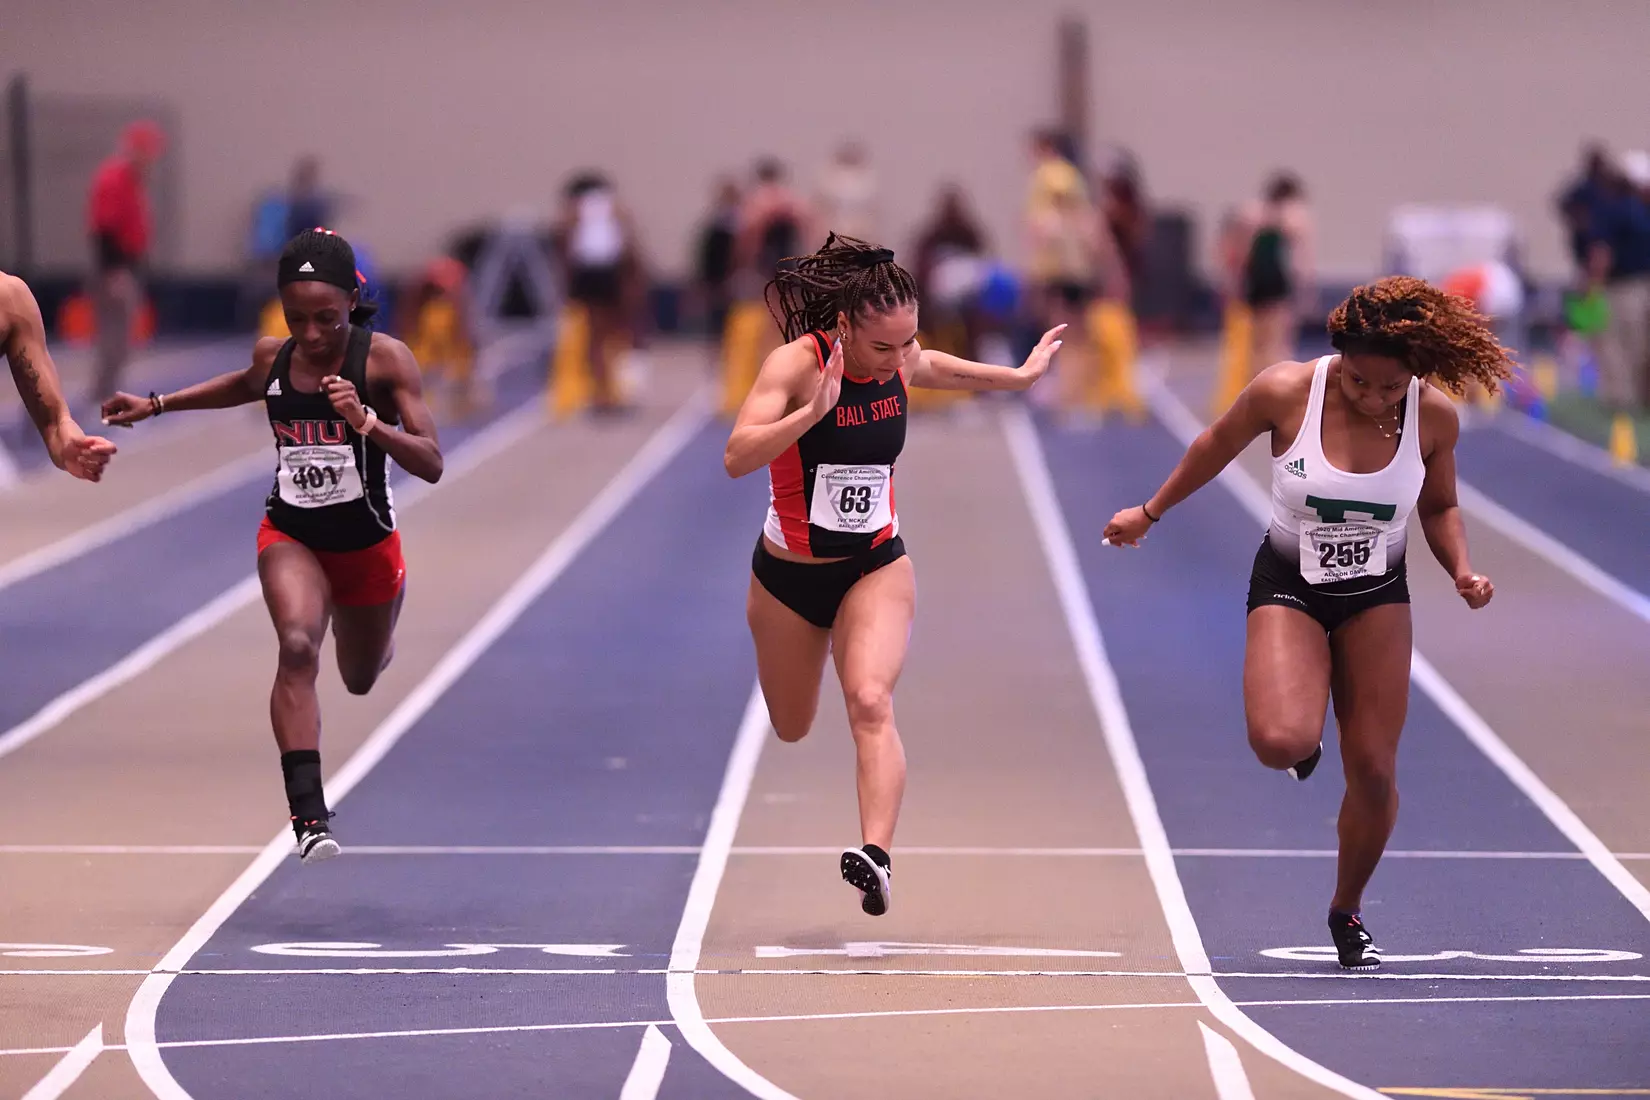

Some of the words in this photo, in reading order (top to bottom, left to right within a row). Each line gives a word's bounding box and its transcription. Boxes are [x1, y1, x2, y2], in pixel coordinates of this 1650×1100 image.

[836, 405, 868, 427] BALL
[870, 395, 902, 421] STATE
[273, 420, 347, 445] NIU
[292, 465, 337, 489] 401
[840, 485, 872, 513] 63
[1305, 530, 1338, 538] Conference
[1319, 539, 1370, 568] 255
